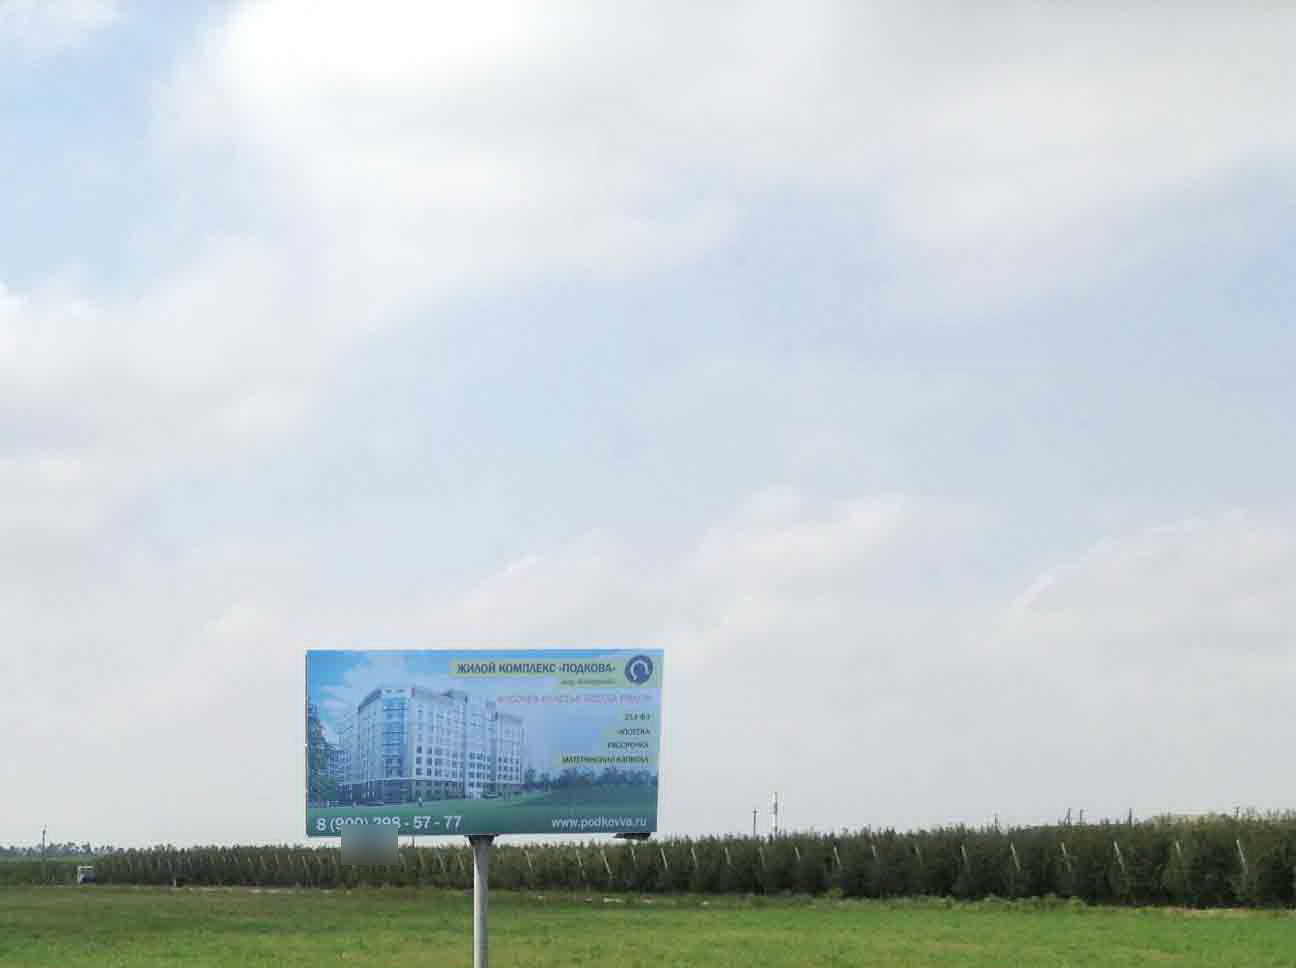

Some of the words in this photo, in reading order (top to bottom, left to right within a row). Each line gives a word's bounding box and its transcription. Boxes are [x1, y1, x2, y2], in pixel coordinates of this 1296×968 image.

[456, 661, 496, 674] ЖИЛОЙ
[499, 662, 556, 674] КОМПЛЕКС
[316, 817, 327, 831] 8
[413, 816, 432, 829] 57
[444, 815, 463, 829] 77
